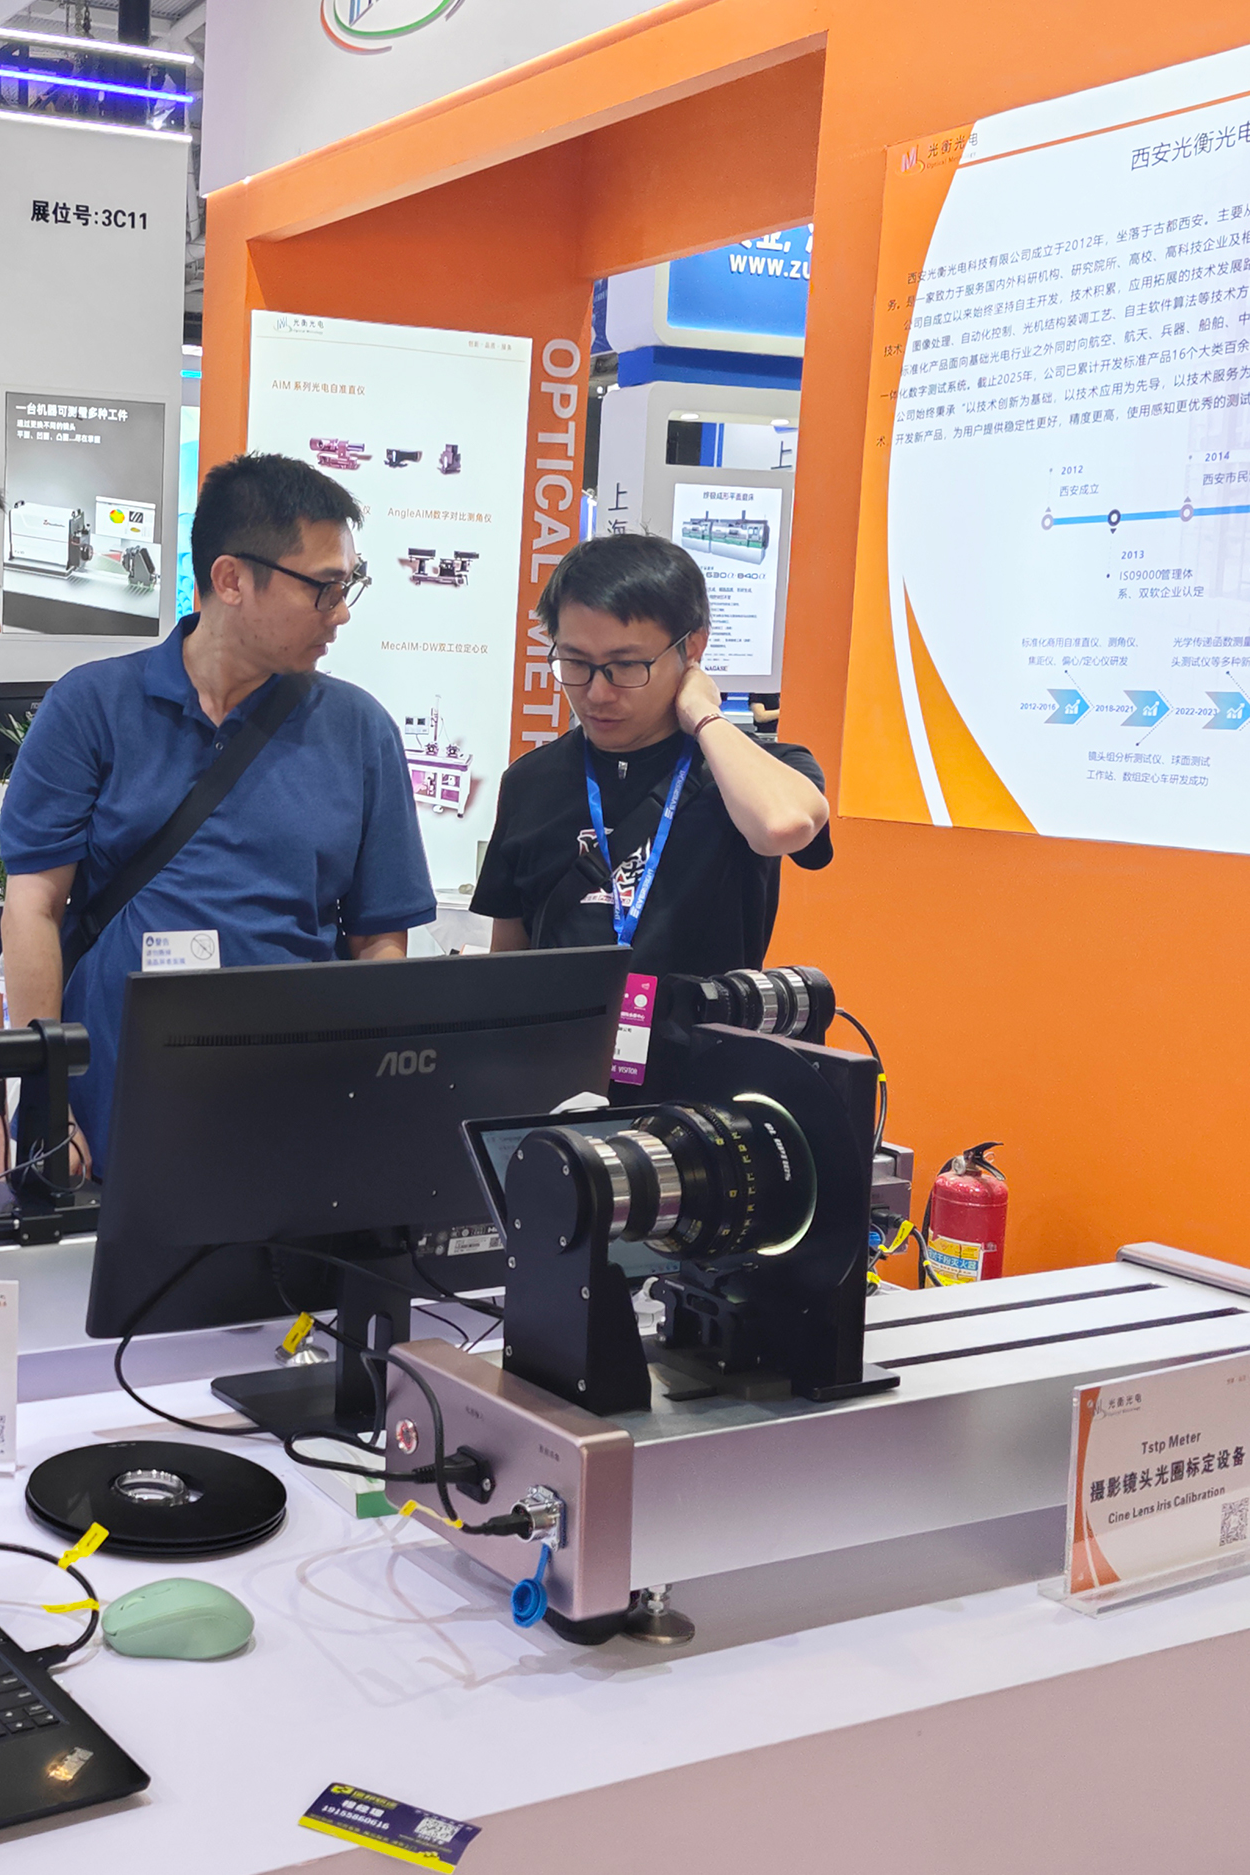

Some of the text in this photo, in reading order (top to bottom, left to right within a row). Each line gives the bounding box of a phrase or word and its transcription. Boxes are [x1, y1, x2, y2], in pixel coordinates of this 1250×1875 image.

[927, 133, 979, 158] 光衡光电
[31, 200, 148, 230] 展位号:3C11
[272, 380, 291, 391] AIM
[530, 338, 581, 584] OPTICAL
[1204, 451, 1230, 462] 2014
[1061, 465, 1084, 475] 2012
[1060, 483, 1100, 497] 西安成立
[1121, 550, 1145, 560] 2013
[1020, 702, 1056, 711] 2012-2016
[1095, 704, 1134, 713] 2018-2021
[376, 1049, 437, 1077] AOC
[1169, 1432, 1201, 1447] Meter
[1090, 1446, 1246, 1503] 摄影镜头光圈标定设备
[1108, 1486, 1225, 1525] Cine Lens Iris Calibration
